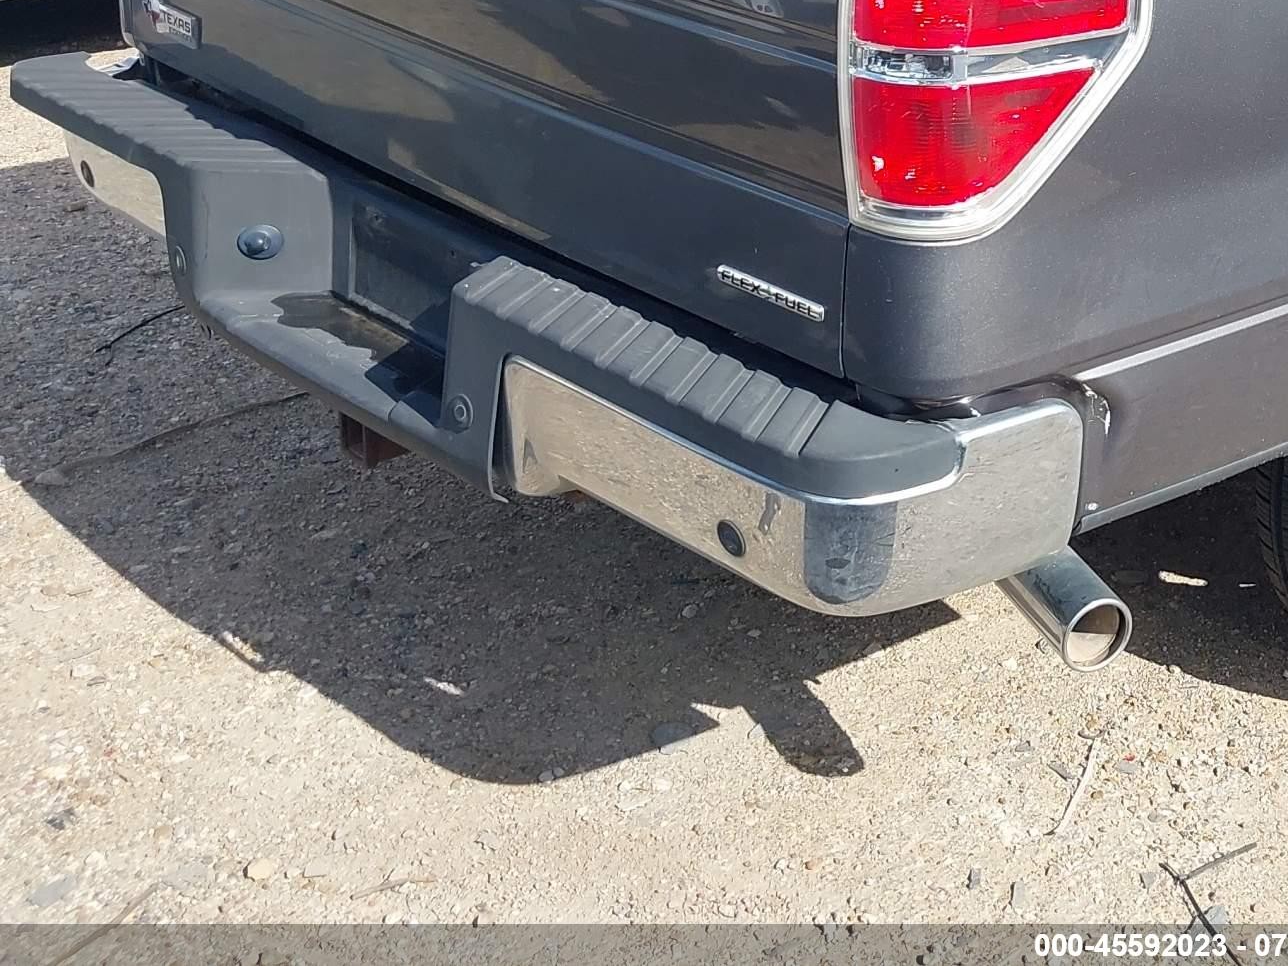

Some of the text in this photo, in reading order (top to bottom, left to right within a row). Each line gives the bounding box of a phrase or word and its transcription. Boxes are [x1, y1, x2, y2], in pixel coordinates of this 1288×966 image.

[161, 10, 192, 35] TEXAS
[720, 269, 822, 320] FLEX FUEL
